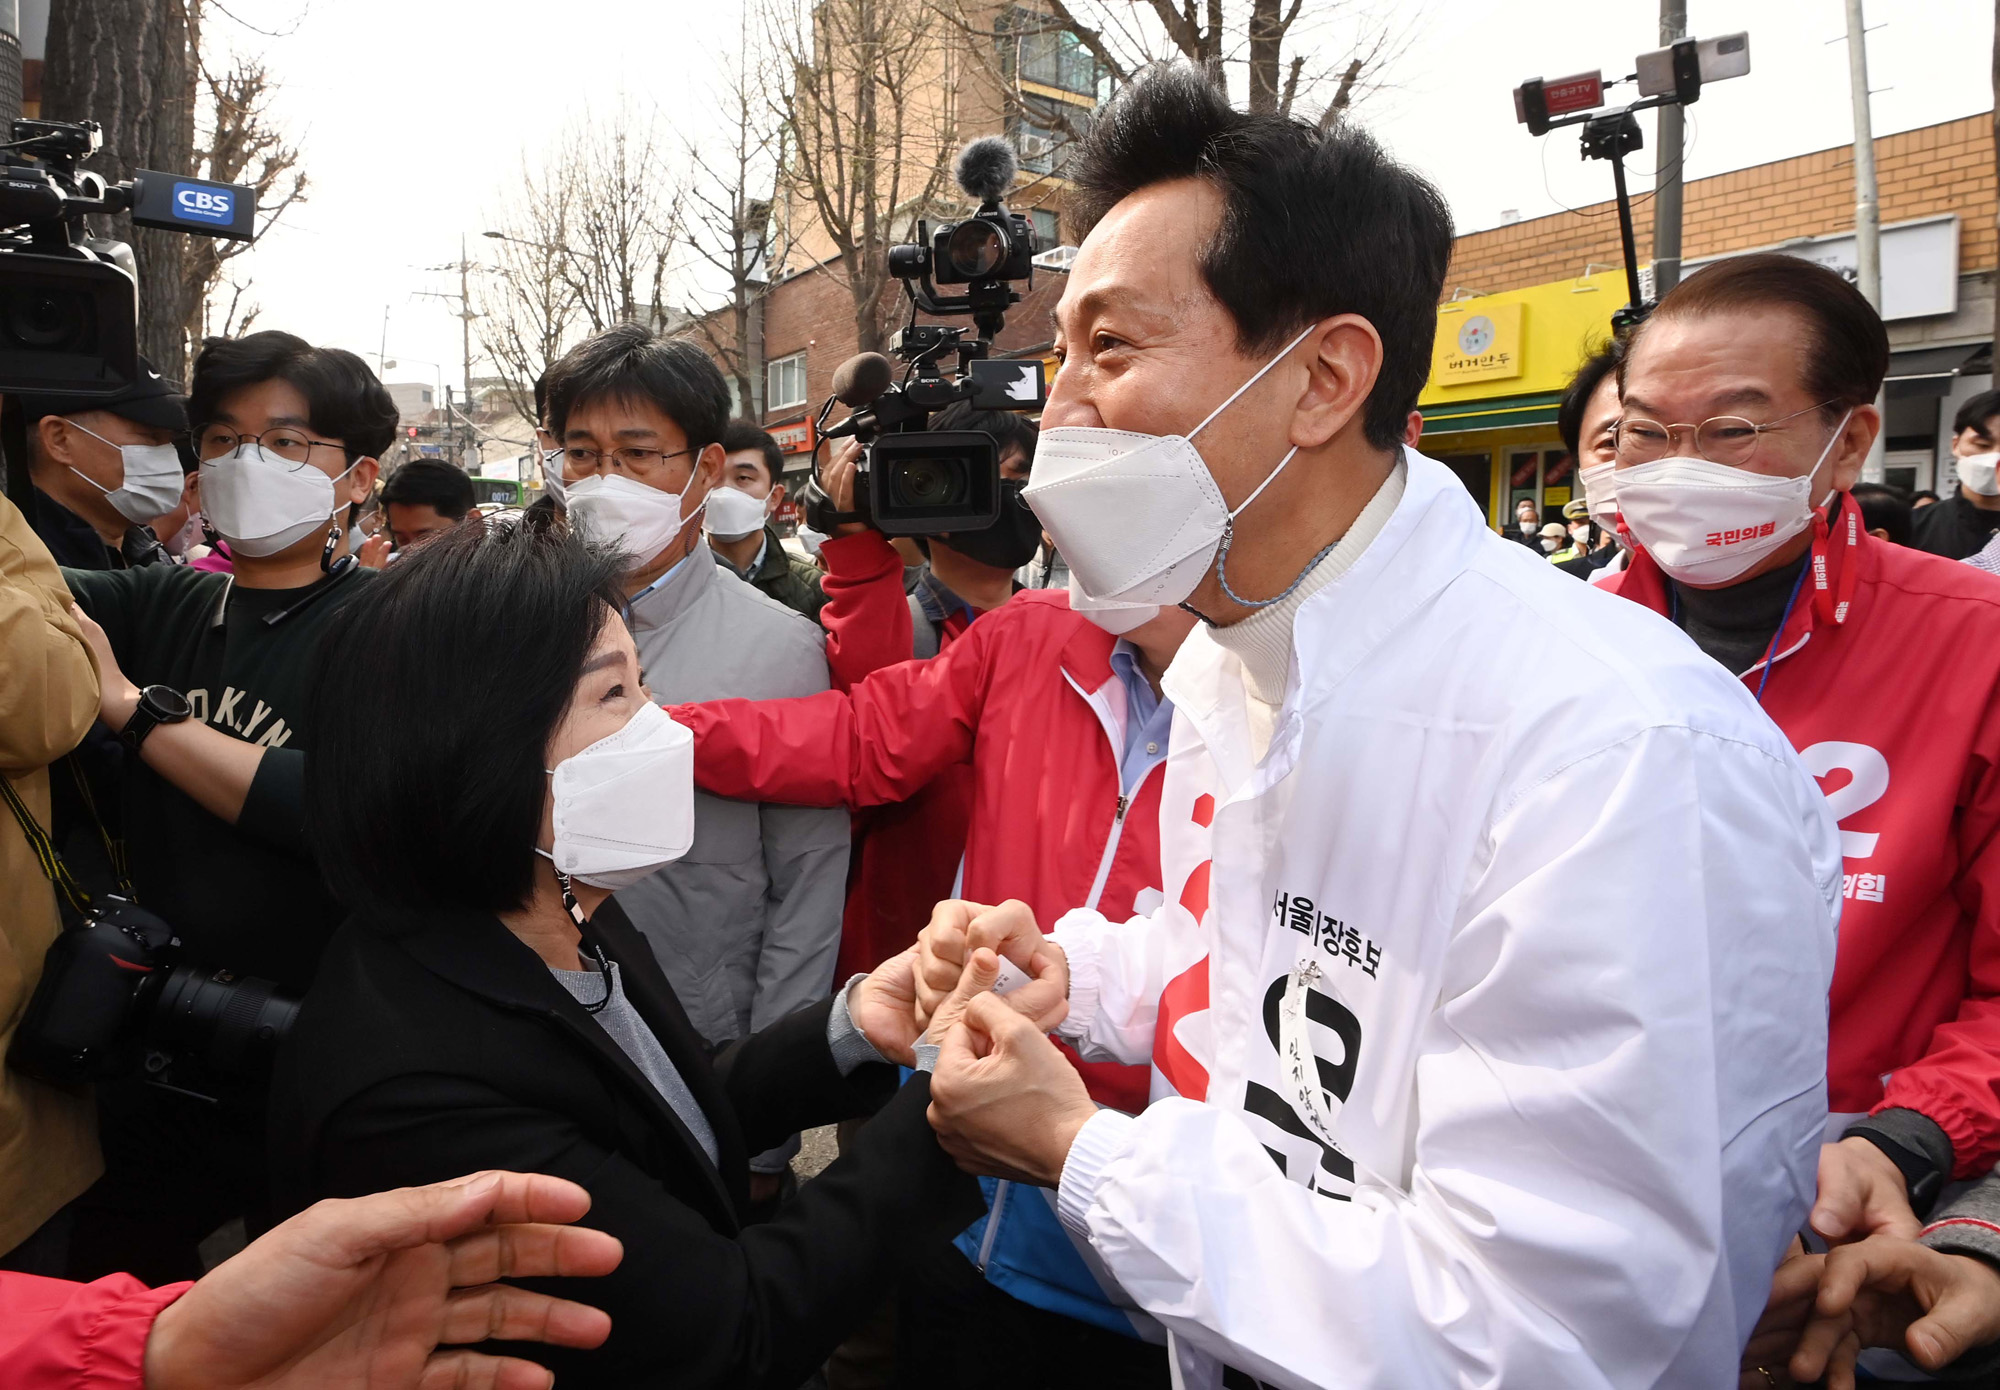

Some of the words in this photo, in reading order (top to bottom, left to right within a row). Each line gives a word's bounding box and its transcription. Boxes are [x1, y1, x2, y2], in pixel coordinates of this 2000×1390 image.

[9, 181, 38, 190] SONY
[178, 190, 230, 212] CBS
[1705, 521, 1777, 547] 국민의힘
[1814, 555, 1828, 590] 국민의힘
[1799, 741, 1890, 859] 2
